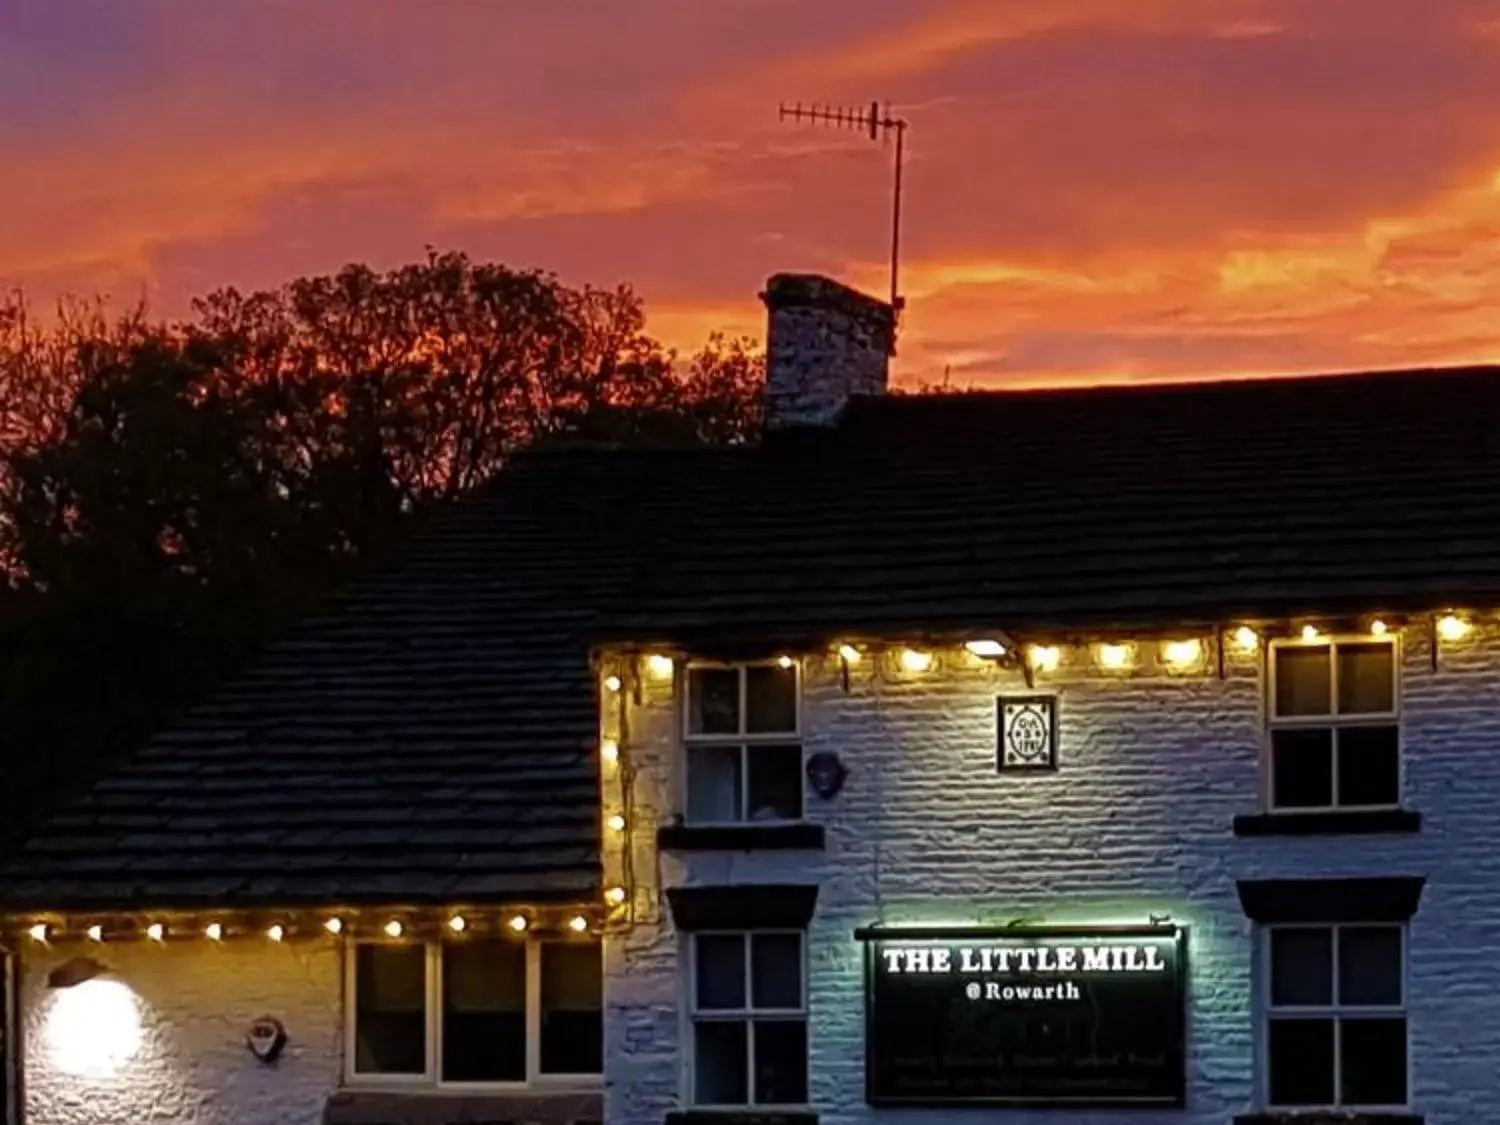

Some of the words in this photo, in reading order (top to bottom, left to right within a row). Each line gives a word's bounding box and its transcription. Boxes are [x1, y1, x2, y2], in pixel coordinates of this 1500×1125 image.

[883, 948, 951, 973] THE
[960, 947, 1077, 972] LITTLE
[1081, 946, 1165, 971] MILL
